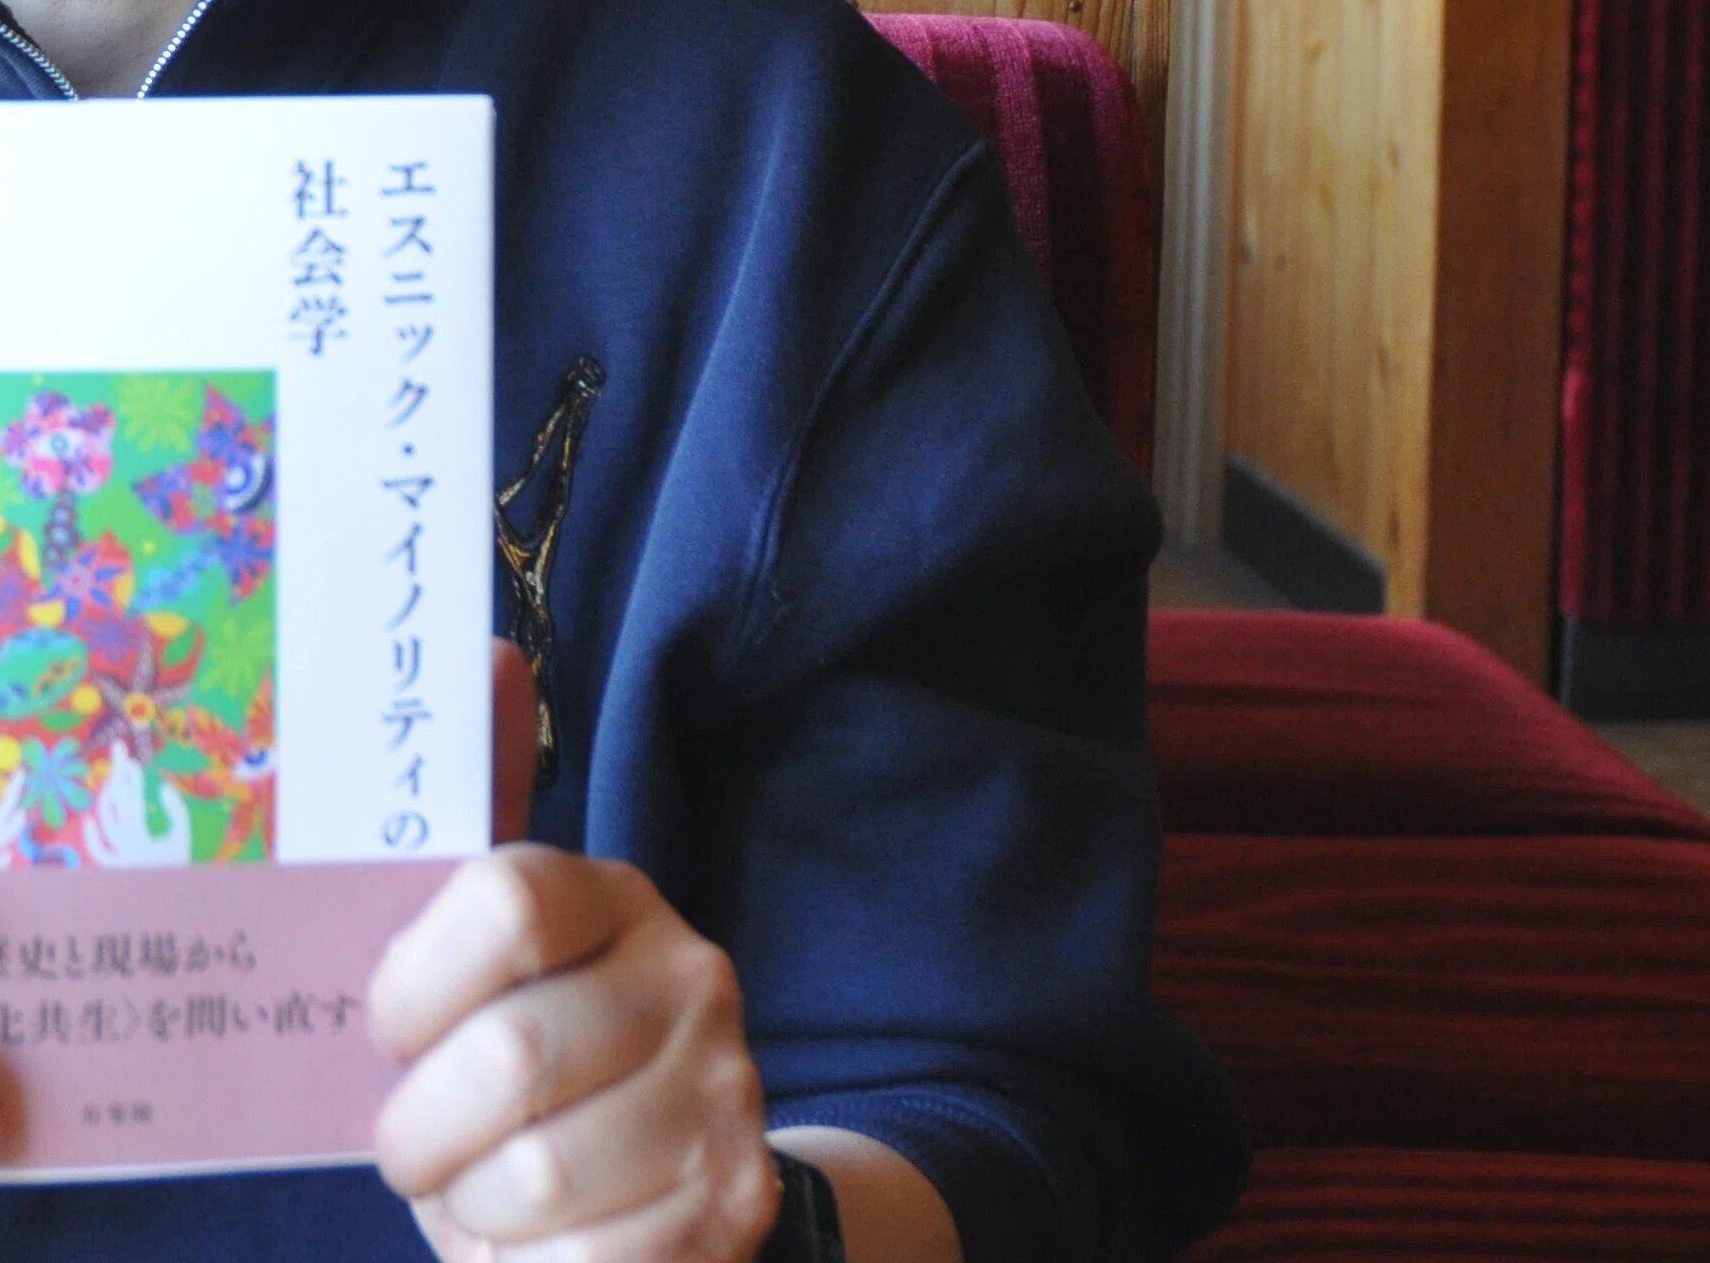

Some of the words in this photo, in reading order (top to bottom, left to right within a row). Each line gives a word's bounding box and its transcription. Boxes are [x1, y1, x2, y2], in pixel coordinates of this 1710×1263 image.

[289, 159, 348, 357] 社会学
[379, 161, 436, 849] エスニック・マイノリティの
